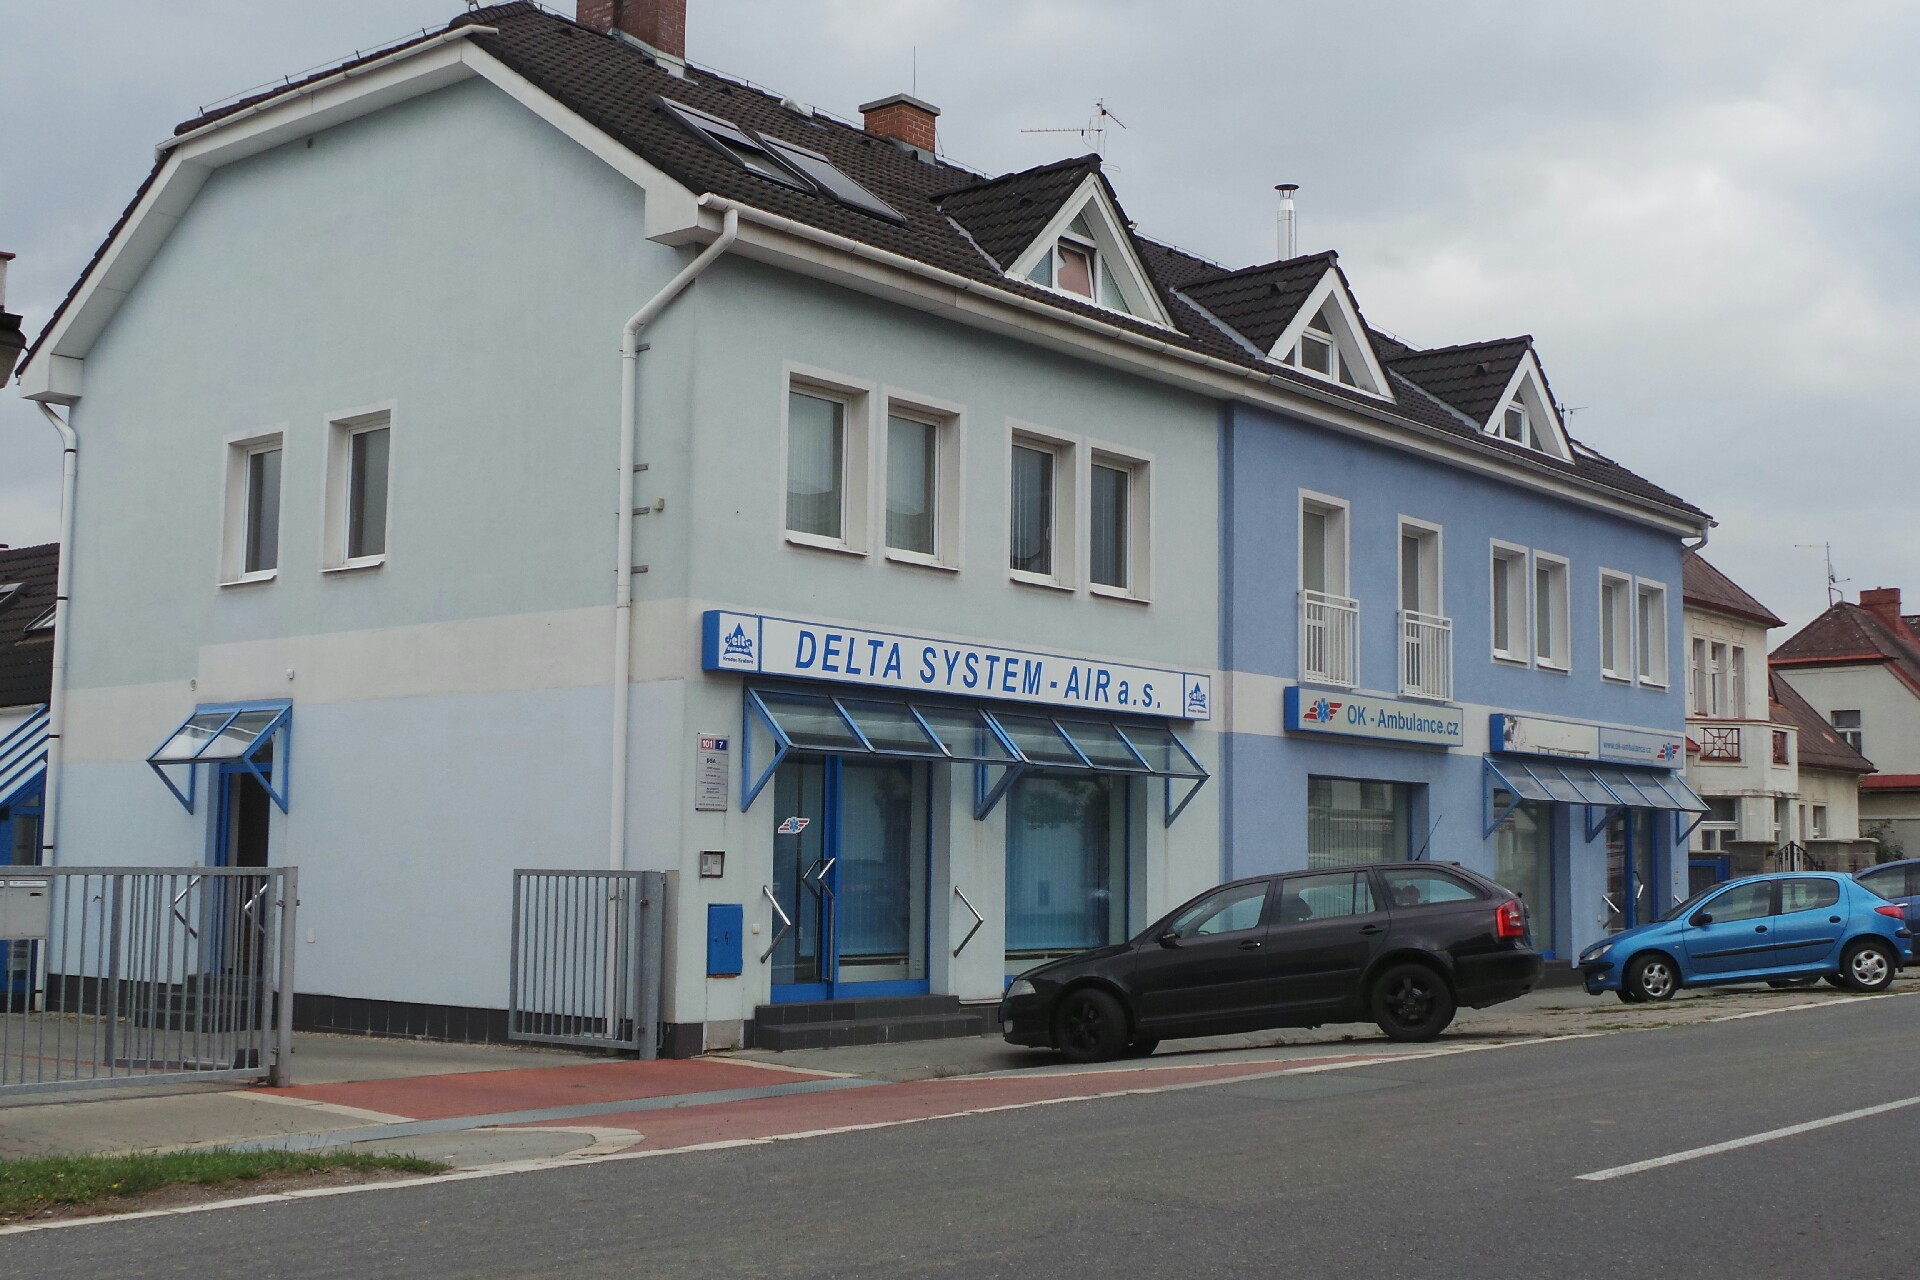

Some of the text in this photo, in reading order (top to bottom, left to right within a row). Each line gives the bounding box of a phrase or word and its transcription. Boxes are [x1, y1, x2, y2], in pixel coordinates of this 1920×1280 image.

[725, 633, 752, 647] delta
[795, 630, 901, 679] DELTA
[919, 646, 1043, 695] SYSTEM
[1347, 704, 1367, 726] OK
[1377, 709, 1459, 736] Ambulance.cz
[702, 740, 713, 748] 101
